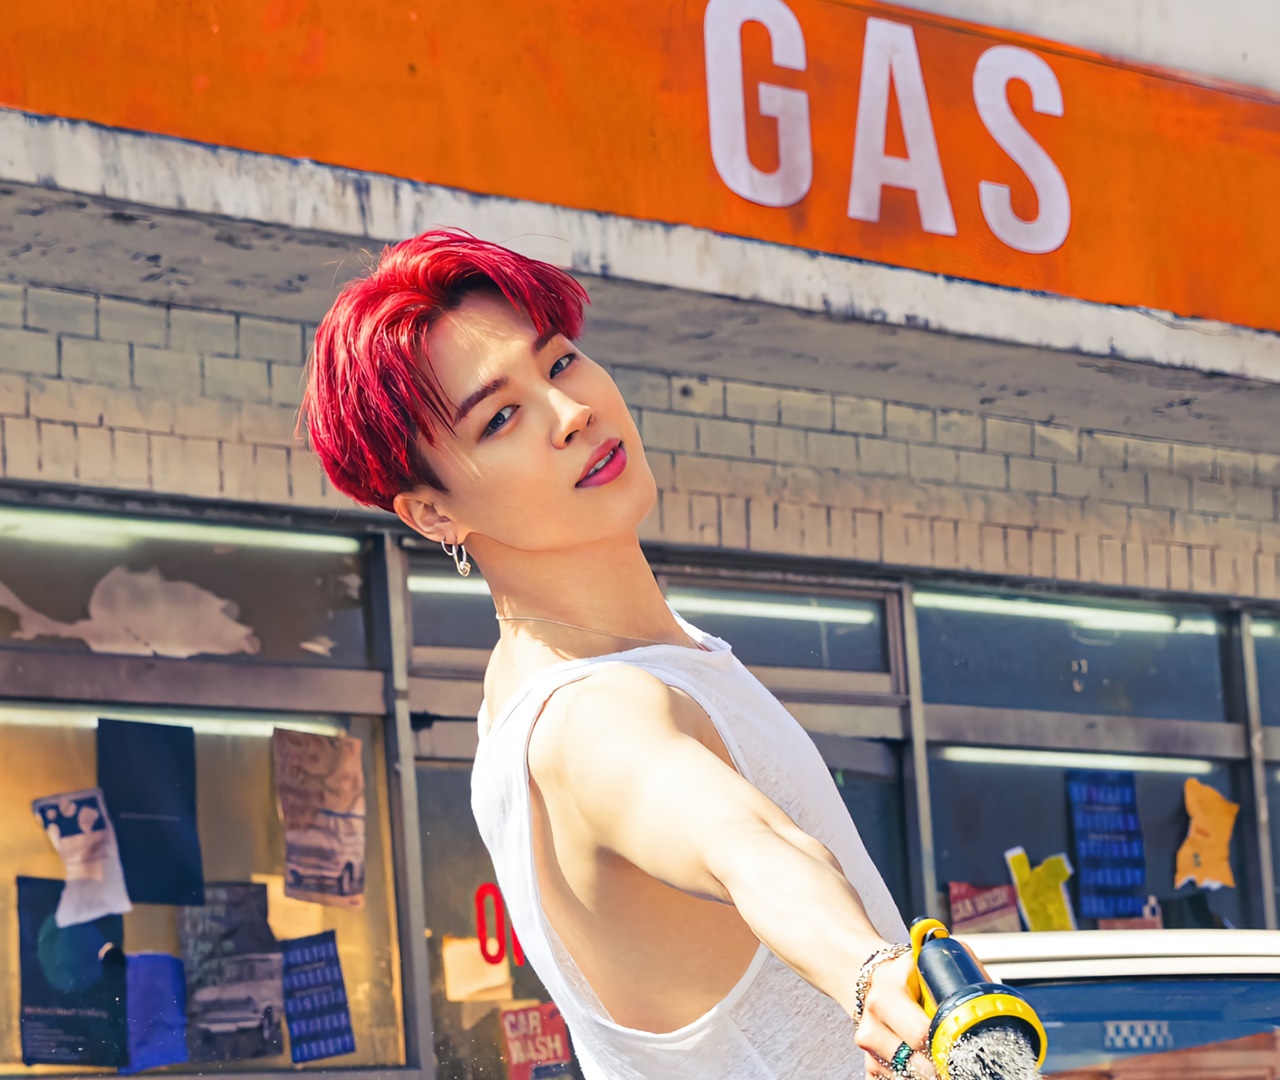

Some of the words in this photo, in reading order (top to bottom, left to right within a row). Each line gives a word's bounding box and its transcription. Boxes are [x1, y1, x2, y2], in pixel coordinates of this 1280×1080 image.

[703, 0, 1071, 255] GAS
[504, 1010, 542, 1041] CAR
[509, 1033, 564, 1067] WASH
